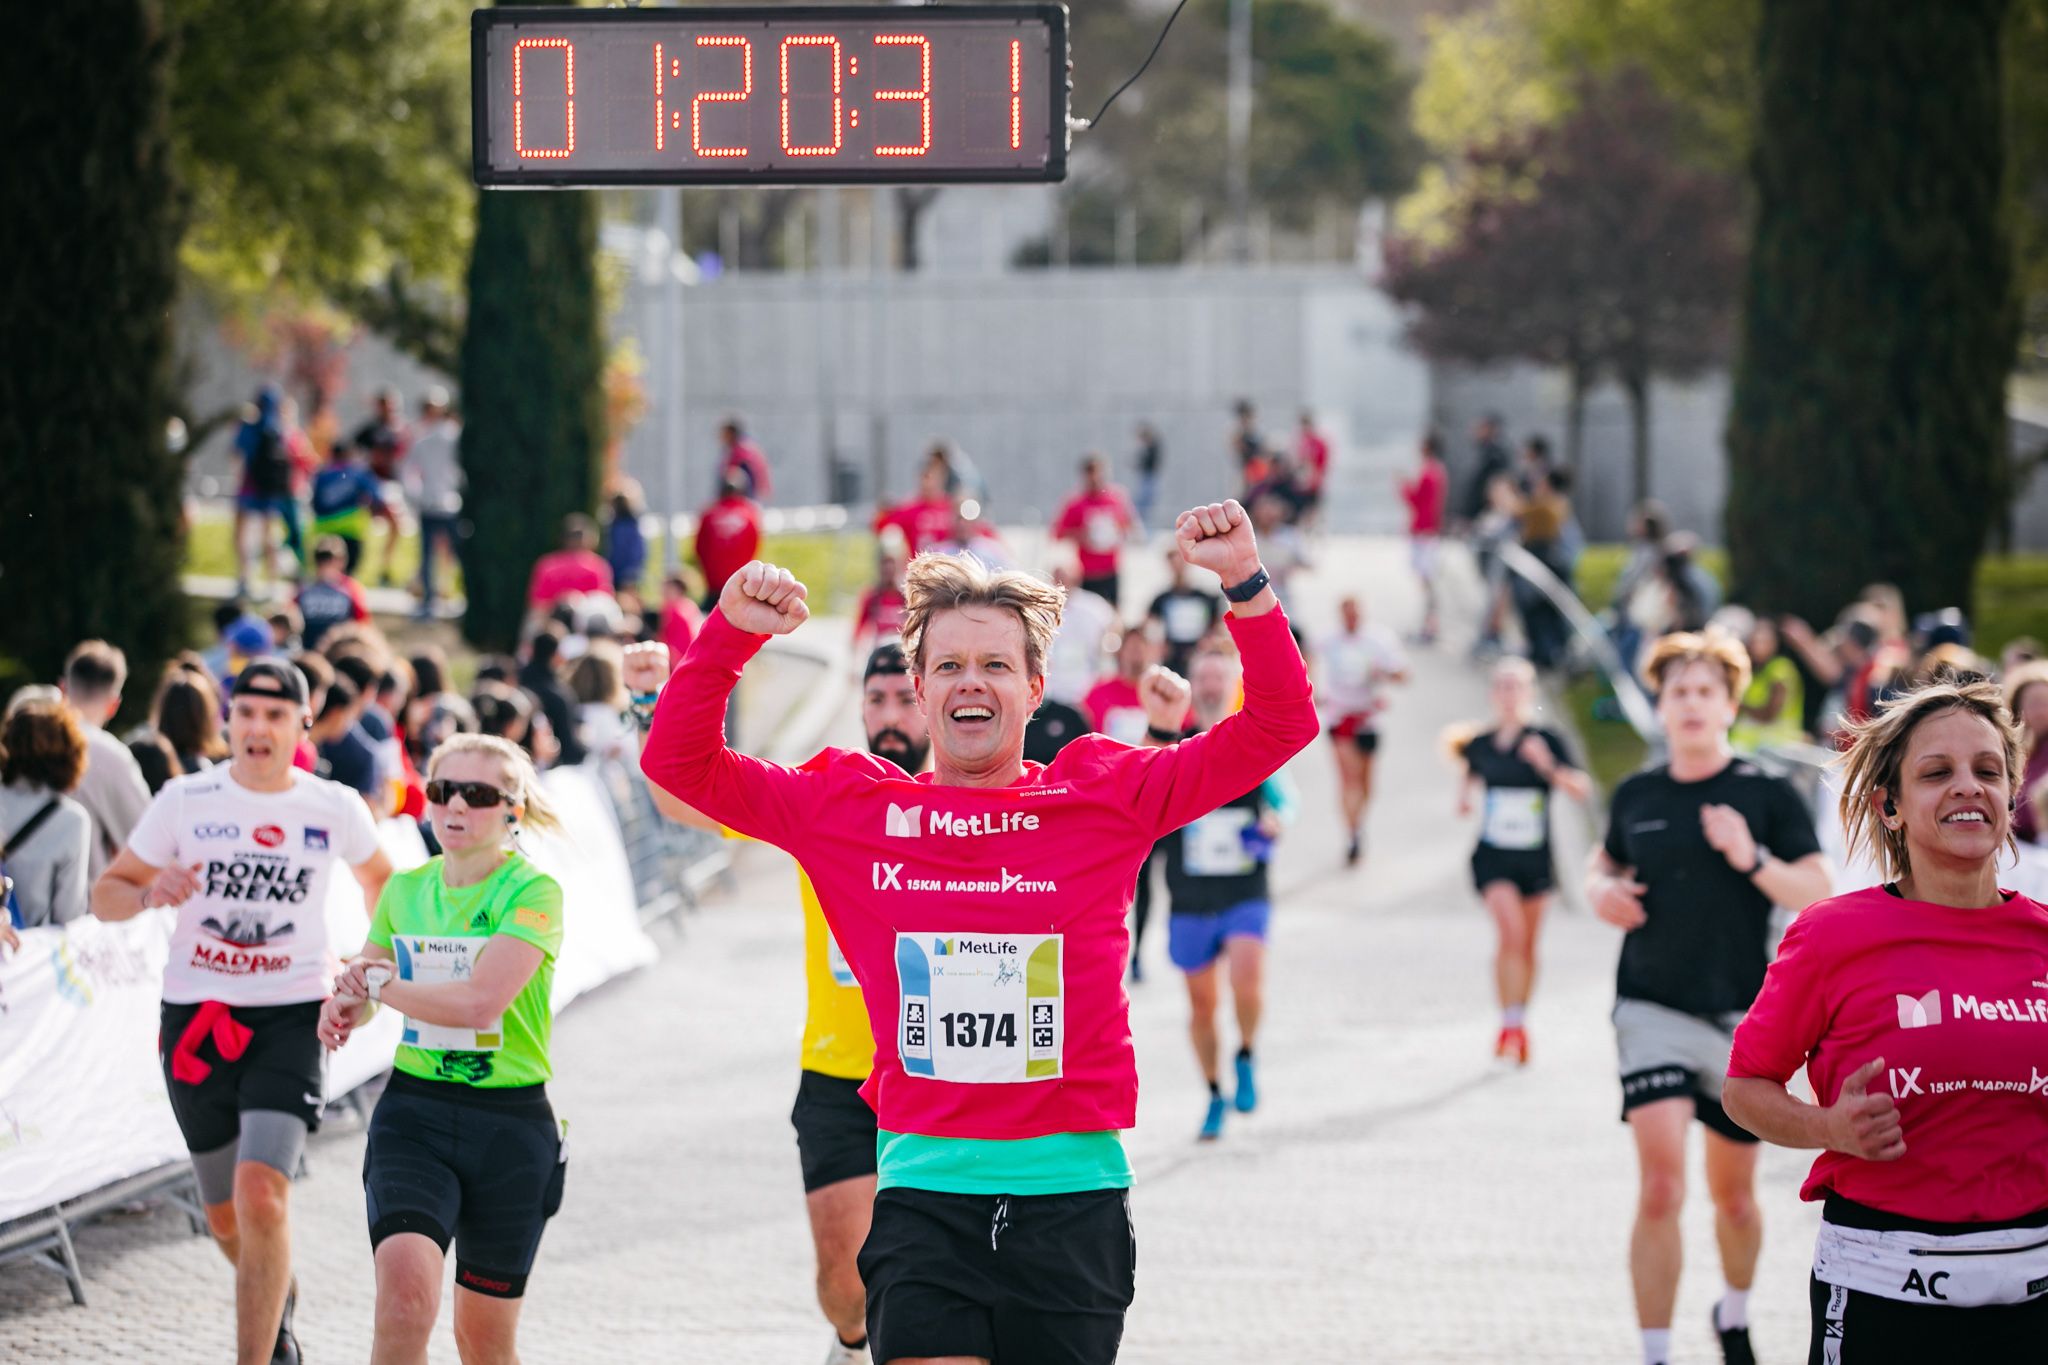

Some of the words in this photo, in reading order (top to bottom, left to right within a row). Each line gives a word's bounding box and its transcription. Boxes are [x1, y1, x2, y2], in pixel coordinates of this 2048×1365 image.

[1020, 787, 1068, 797] BOOMERANG
[929, 811, 1040, 837] MetLife
[206, 861, 314, 883] PONLE
[872, 861, 904, 891] IX
[906, 879, 941, 892] 15KM
[206, 880, 308, 904] FRENO
[428, 943, 468, 954] MetLife
[960, 940, 1018, 955] MetLife
[933, 967, 944, 977] IX
[1952, 994, 2048, 1023] MetLif
[940, 1012, 1018, 1048] 1374
[1889, 1066, 1925, 1099] IX
[1930, 1079, 1967, 1094] 15KM
[1901, 1268, 1951, 1300] AC
